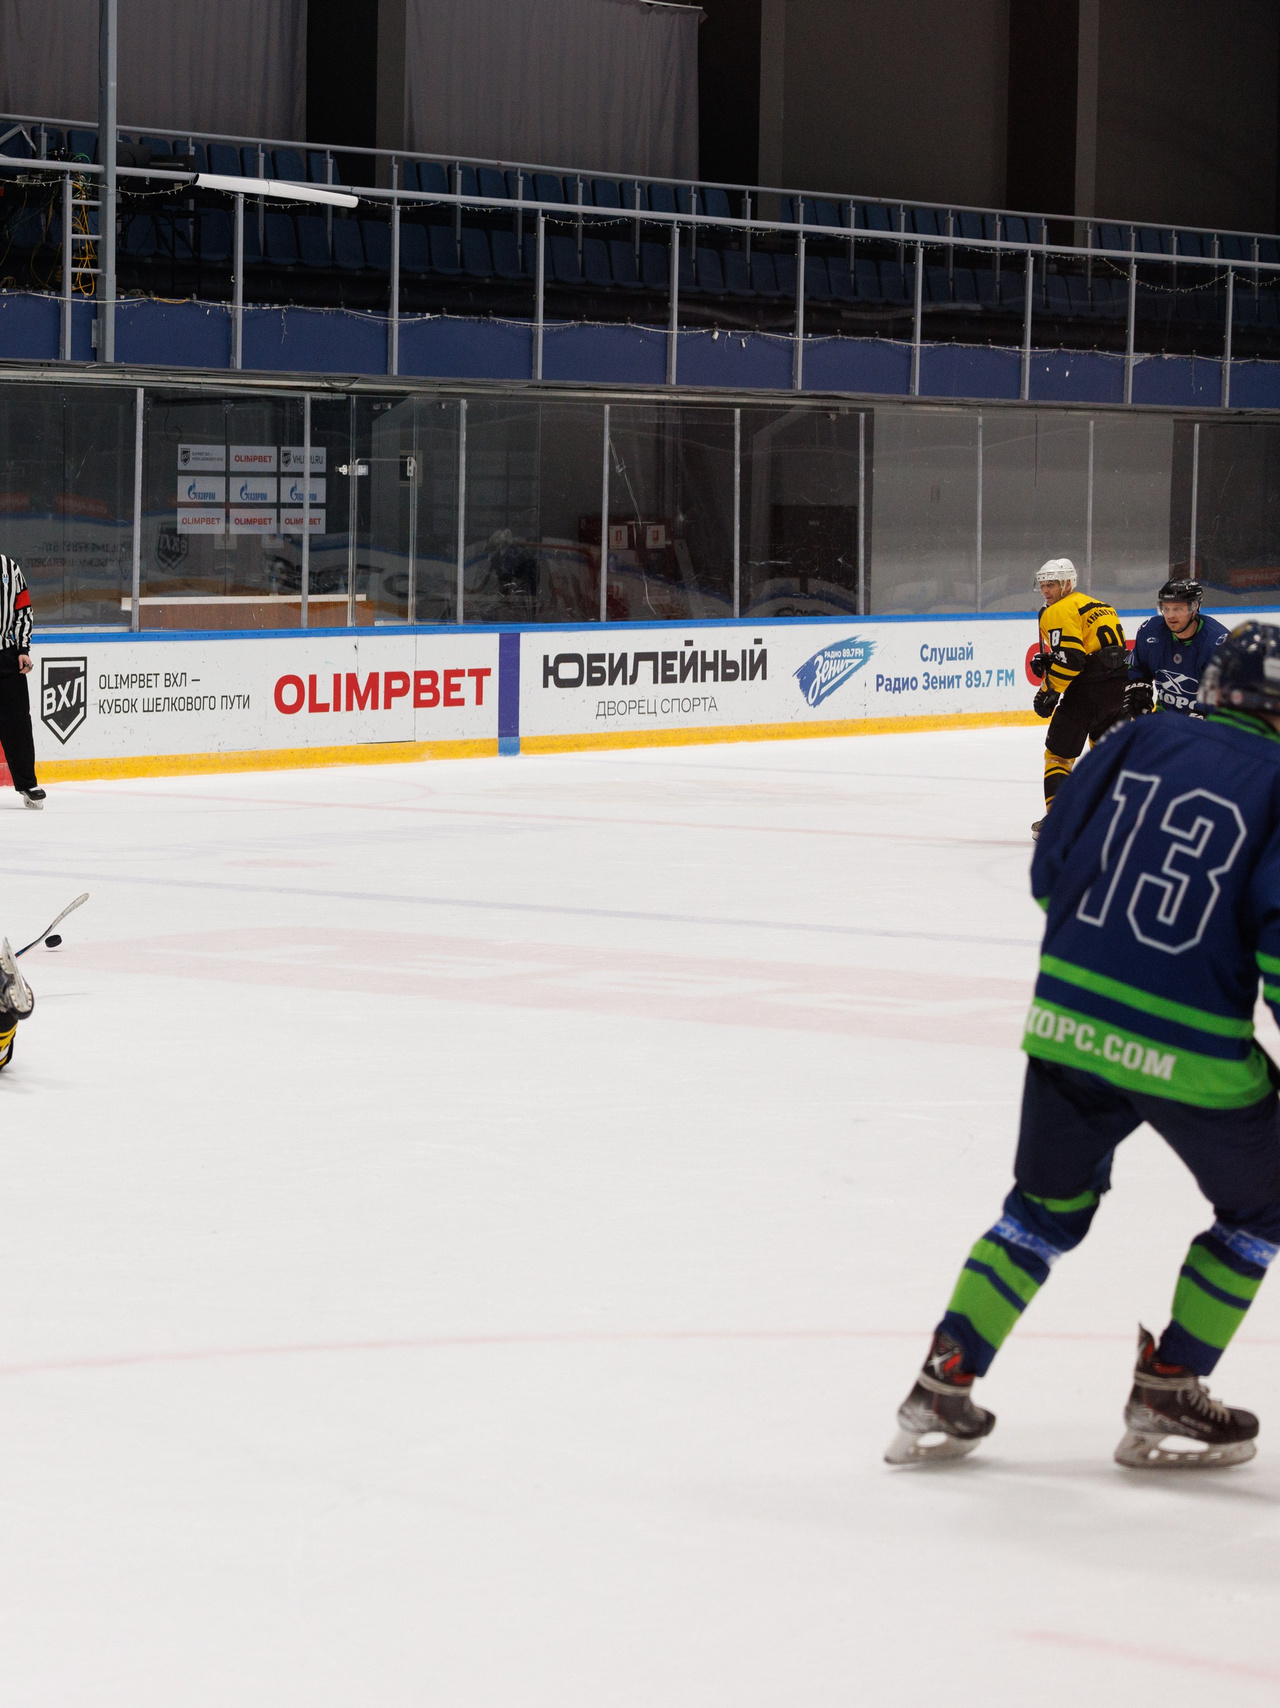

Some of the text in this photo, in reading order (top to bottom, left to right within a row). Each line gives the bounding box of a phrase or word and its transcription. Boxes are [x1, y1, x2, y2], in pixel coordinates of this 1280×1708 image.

[234, 455, 273, 463] OLIMPBET
[292, 455, 324, 464] VHLU.RU
[181, 517, 221, 525] OLIMPBET
[234, 517, 273, 525] OLIMPBET
[542, 638, 768, 689] ЮБИЛЕЙНЫЙ
[824, 651, 842, 659] РАДИО
[919, 642, 974, 666] Слушай
[98, 673, 160, 690] OLIMPBET
[164, 672, 187, 688] ВХЛ
[273, 667, 492, 715] OLIMPBET
[875, 669, 1015, 695] Радио Зенит 89.7 FM
[43, 675, 85, 718] ВХЛ
[98, 695, 250, 715] КУБОК ШЕЛКОВОГО ПУТИ
[596, 696, 718, 720] ДВОРЕЦ СПОРТА
[1076, 770, 1247, 955] 13
